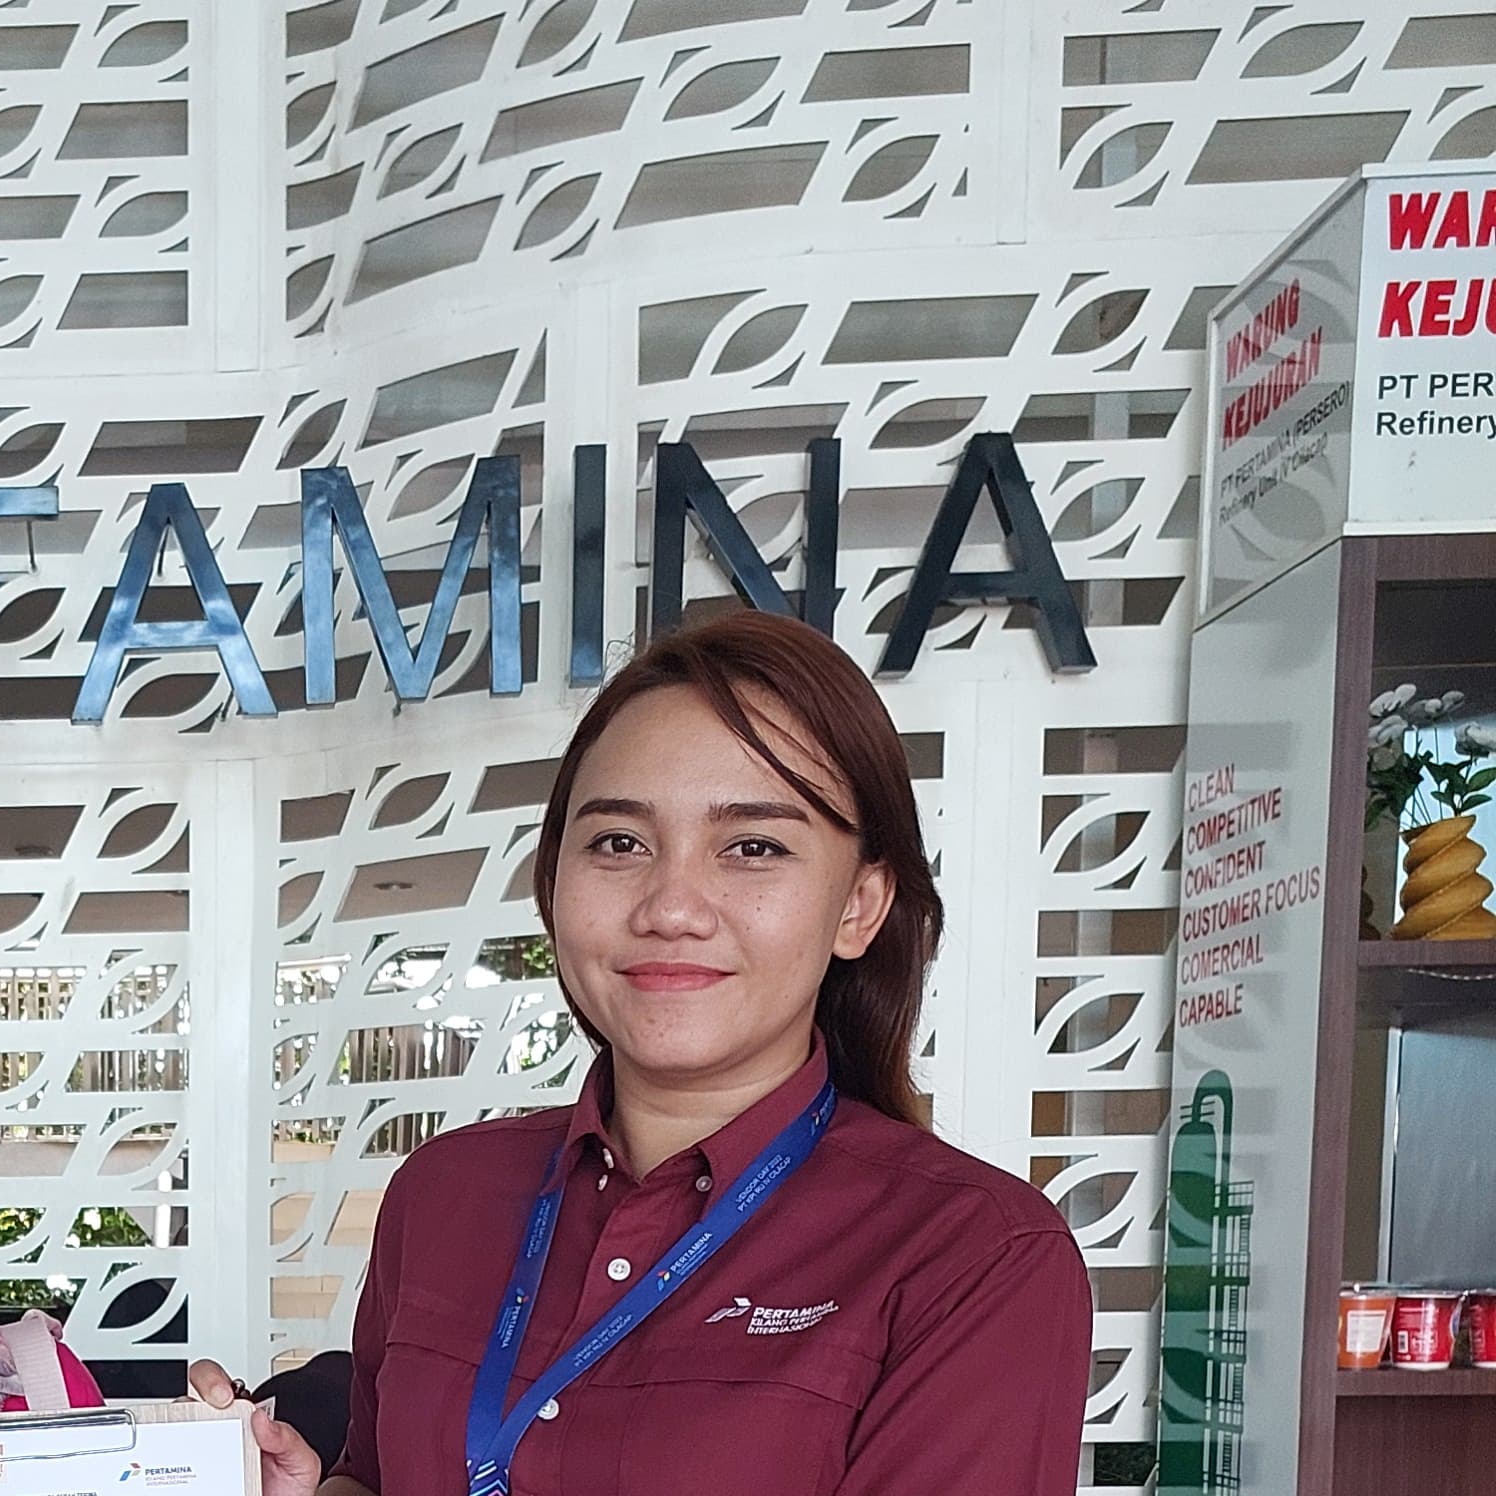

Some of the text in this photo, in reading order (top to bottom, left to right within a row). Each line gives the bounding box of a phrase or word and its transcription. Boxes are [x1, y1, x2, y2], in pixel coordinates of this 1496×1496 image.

[1226, 278, 1300, 384] WARUNG
[1223, 325, 1322, 451] KEJUJURAN
[1378, 374, 1418, 400] PT
[1235, 429, 1291, 489] PERTAMINA
[1293, 380, 1351, 444] (PERSERO)
[1376, 410, 1496, 440] Refinery
[1219, 487, 1256, 527] Refinery
[1257, 468, 1278, 499] Unit
[1188, 763, 1235, 812] CLEAN
[1186, 787, 1282, 855] COMPETITIVE
[1185, 840, 1266, 898] CONFIDENT
[1183, 865, 1321, 942] CUSTOMER FOCUS
[1181, 934, 1264, 985] COMERCIAL
[1179, 984, 1244, 1028] CAPABLE
[670, 1232, 712, 1272] PERTAMINA
[754, 1300, 835, 1319] PERTAMINA
[145, 1466, 192, 1475] PERTAMINA
